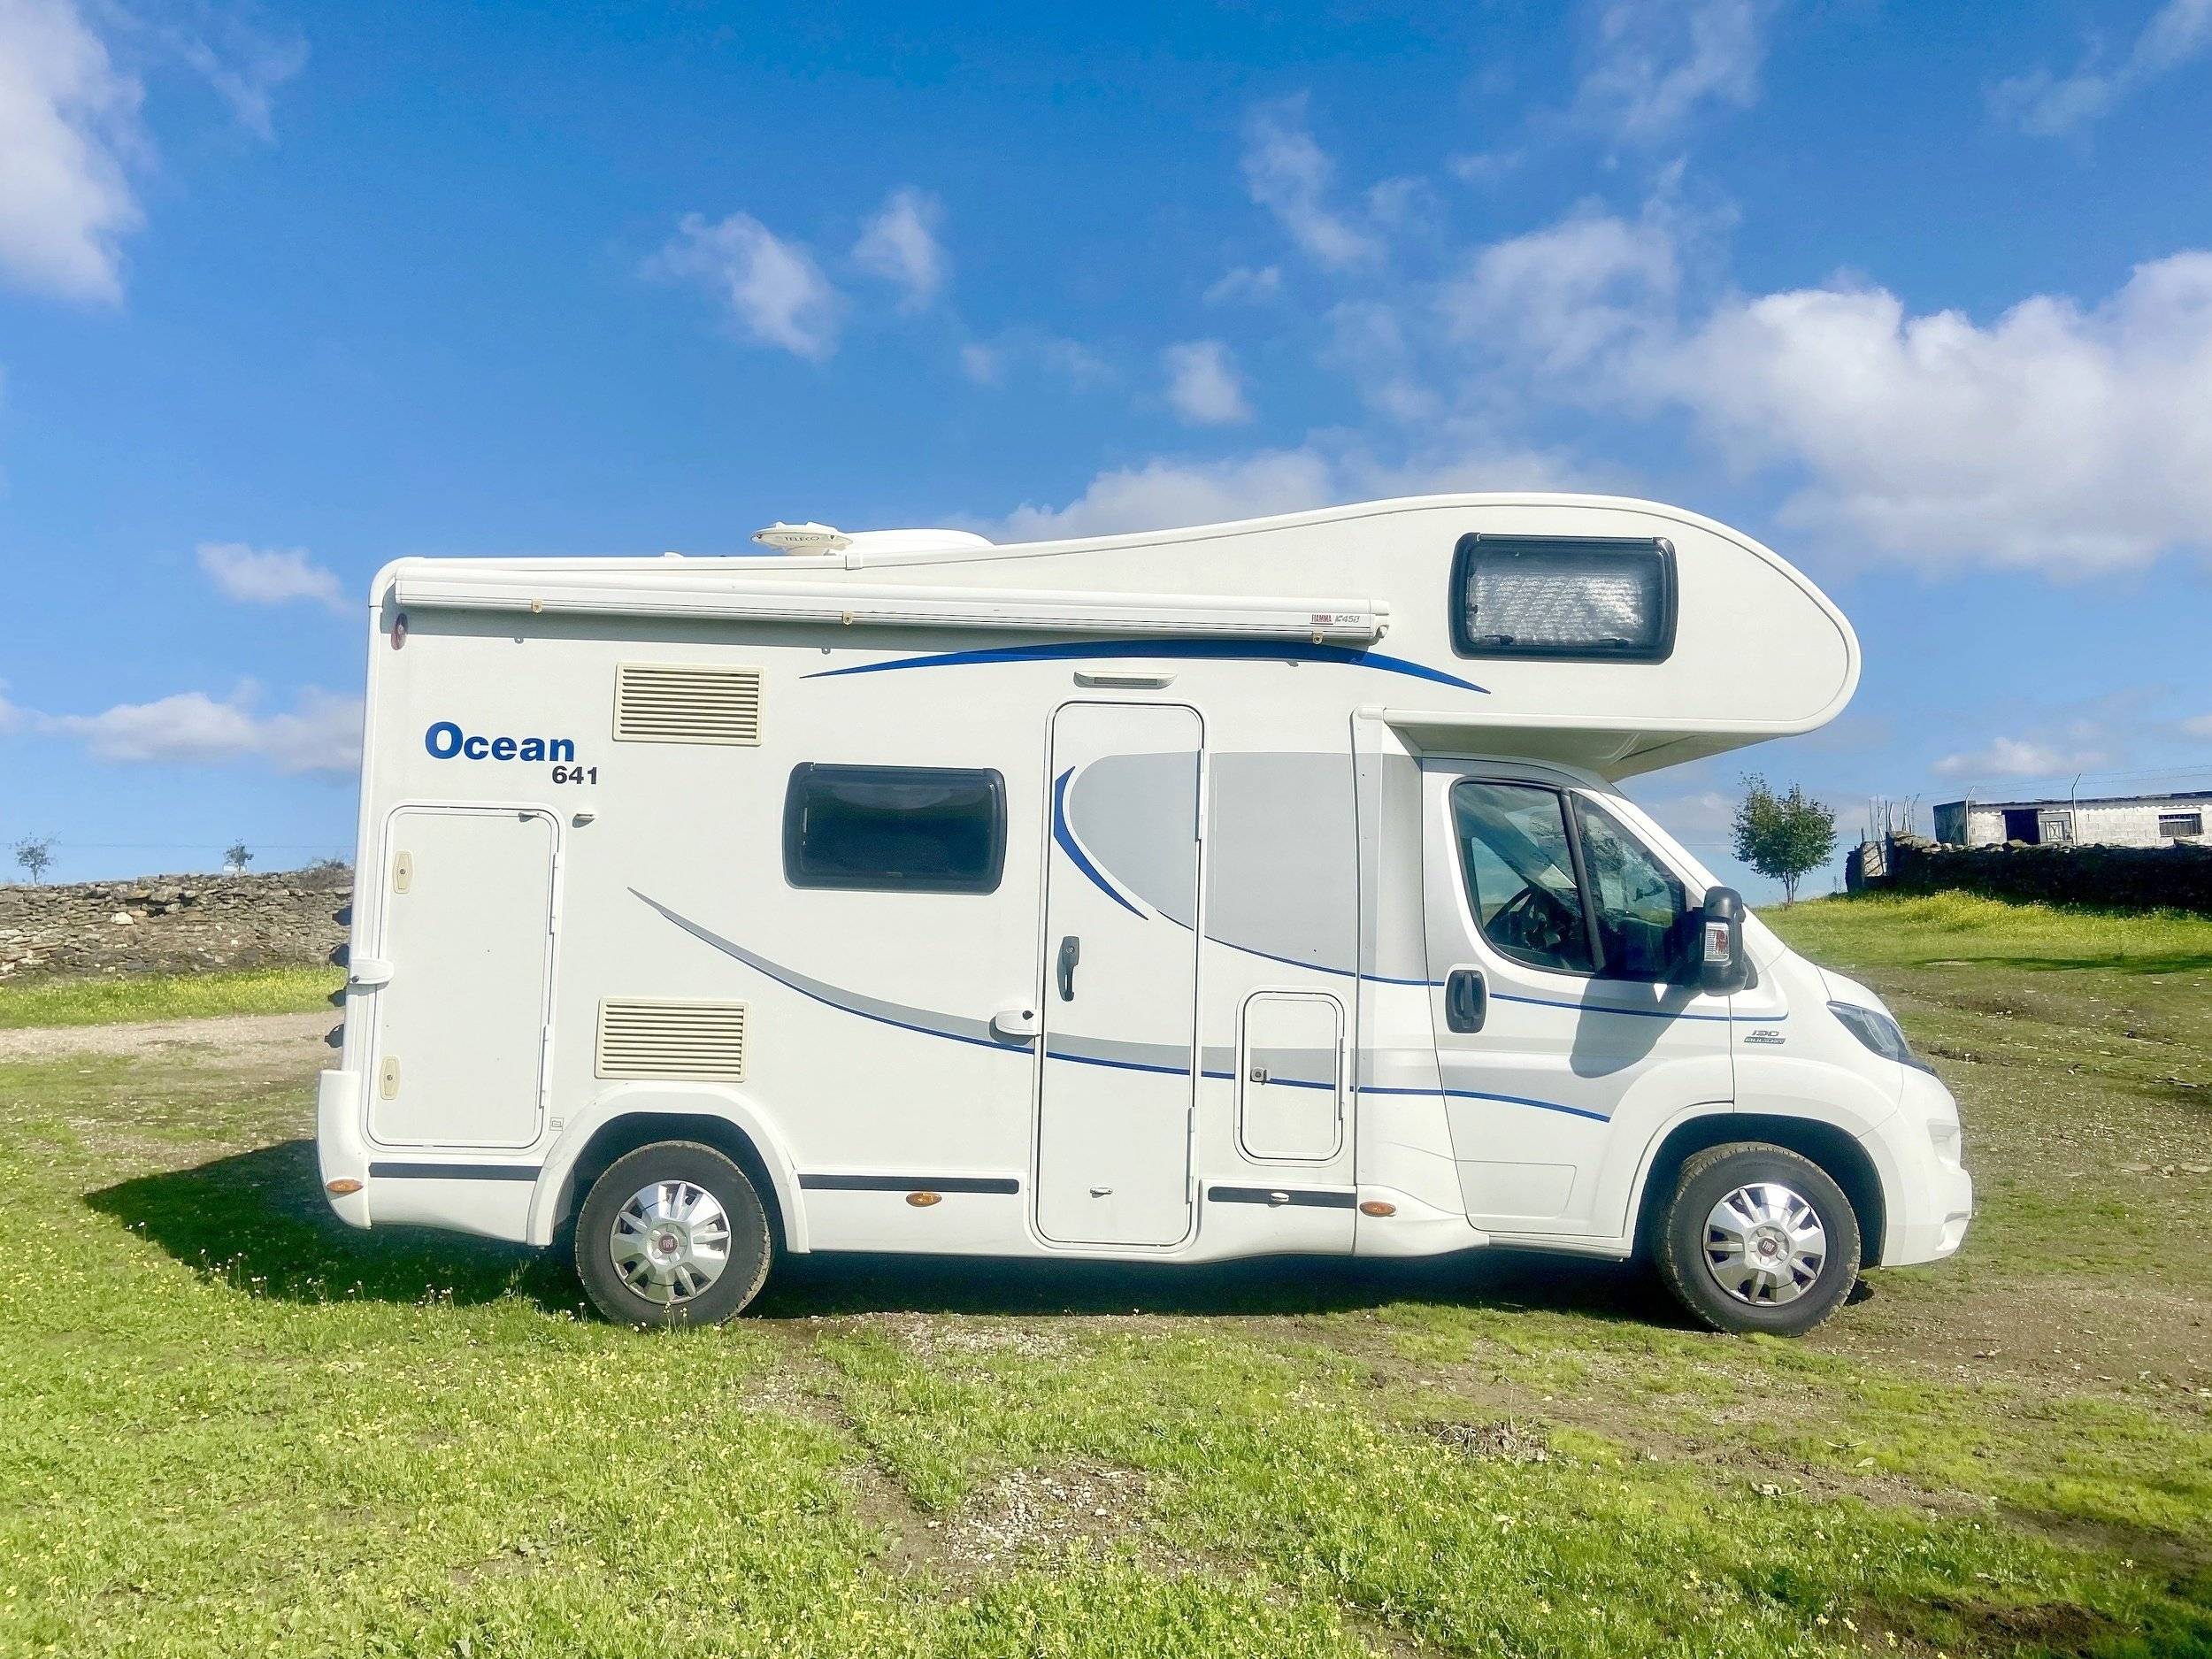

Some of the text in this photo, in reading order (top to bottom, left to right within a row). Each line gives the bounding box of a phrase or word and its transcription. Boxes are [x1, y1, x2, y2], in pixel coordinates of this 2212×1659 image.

[1311, 614, 1332, 623] FIAMMA
[425, 721, 574, 763] Ocean
[552, 765, 597, 785] 641
